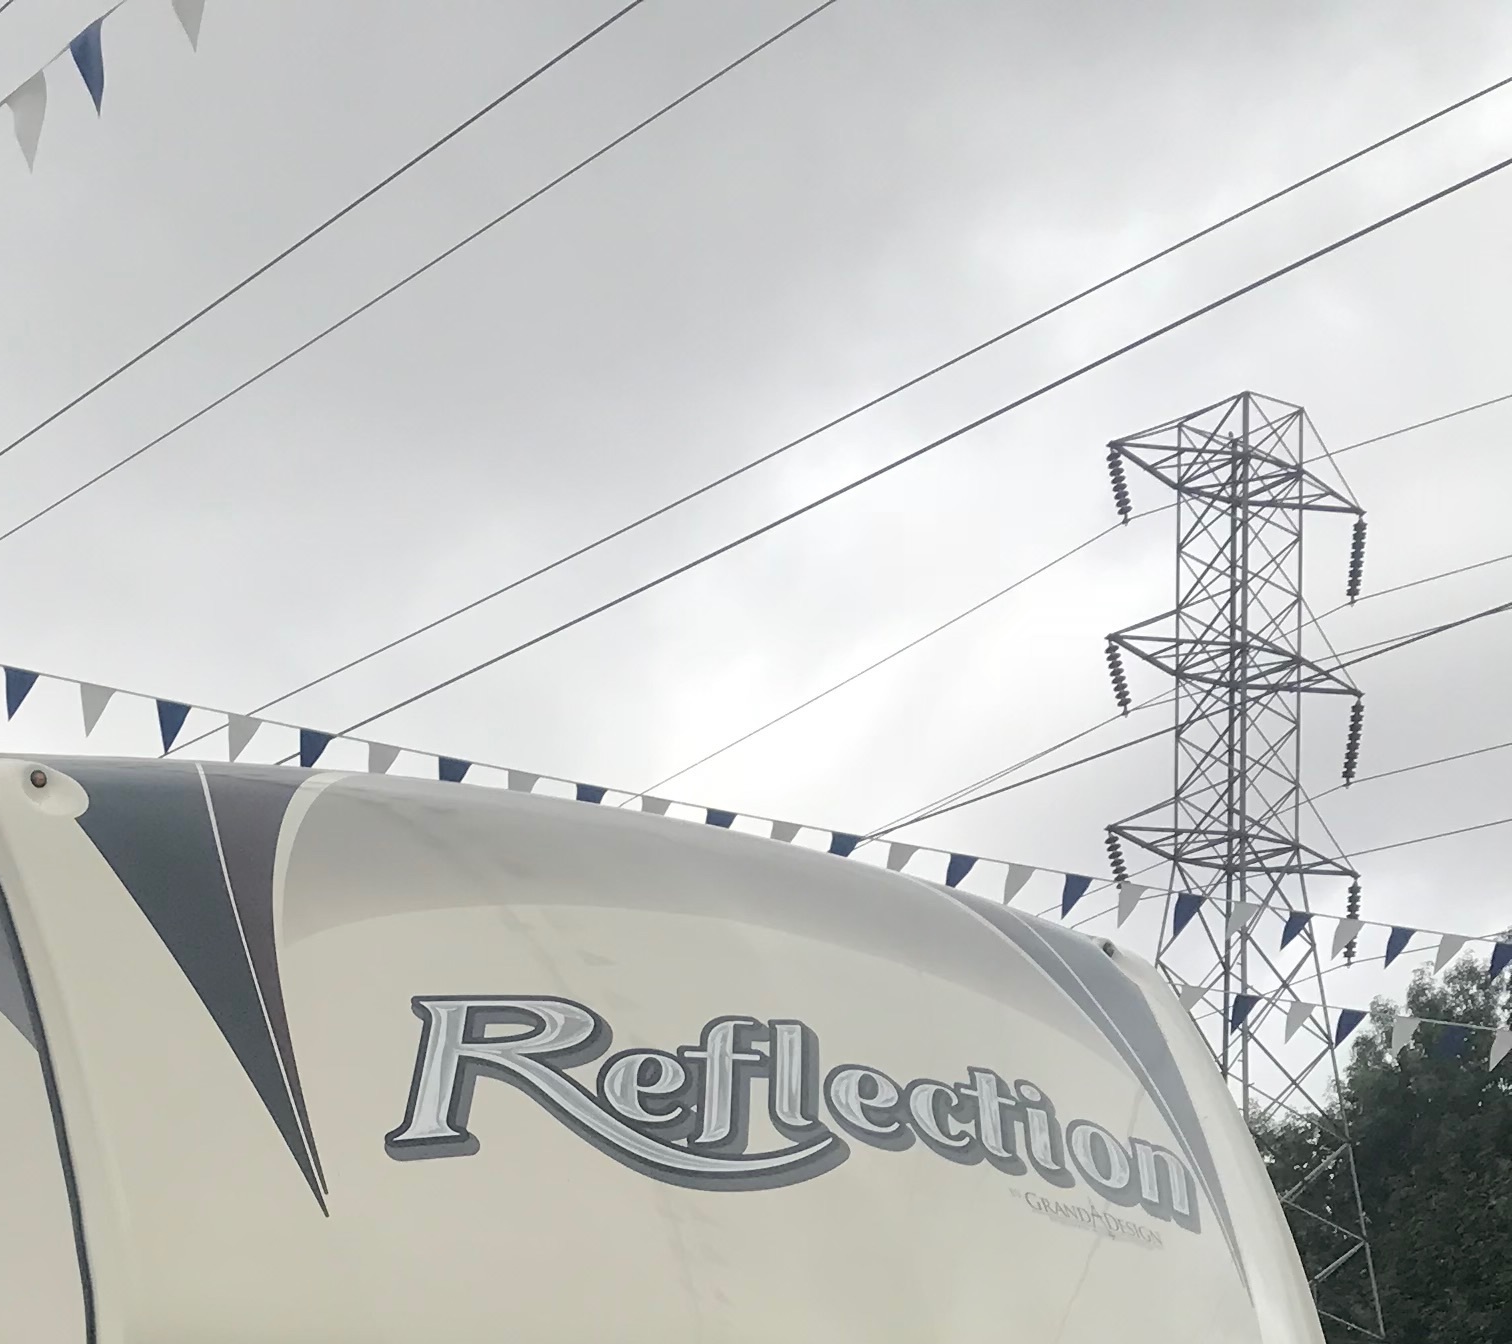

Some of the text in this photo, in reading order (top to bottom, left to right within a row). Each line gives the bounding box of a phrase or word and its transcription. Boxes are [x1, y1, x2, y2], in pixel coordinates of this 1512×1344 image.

[384, 994, 1202, 1234] Reflection
[1024, 1191, 1164, 1248] GRAND DESIGN
